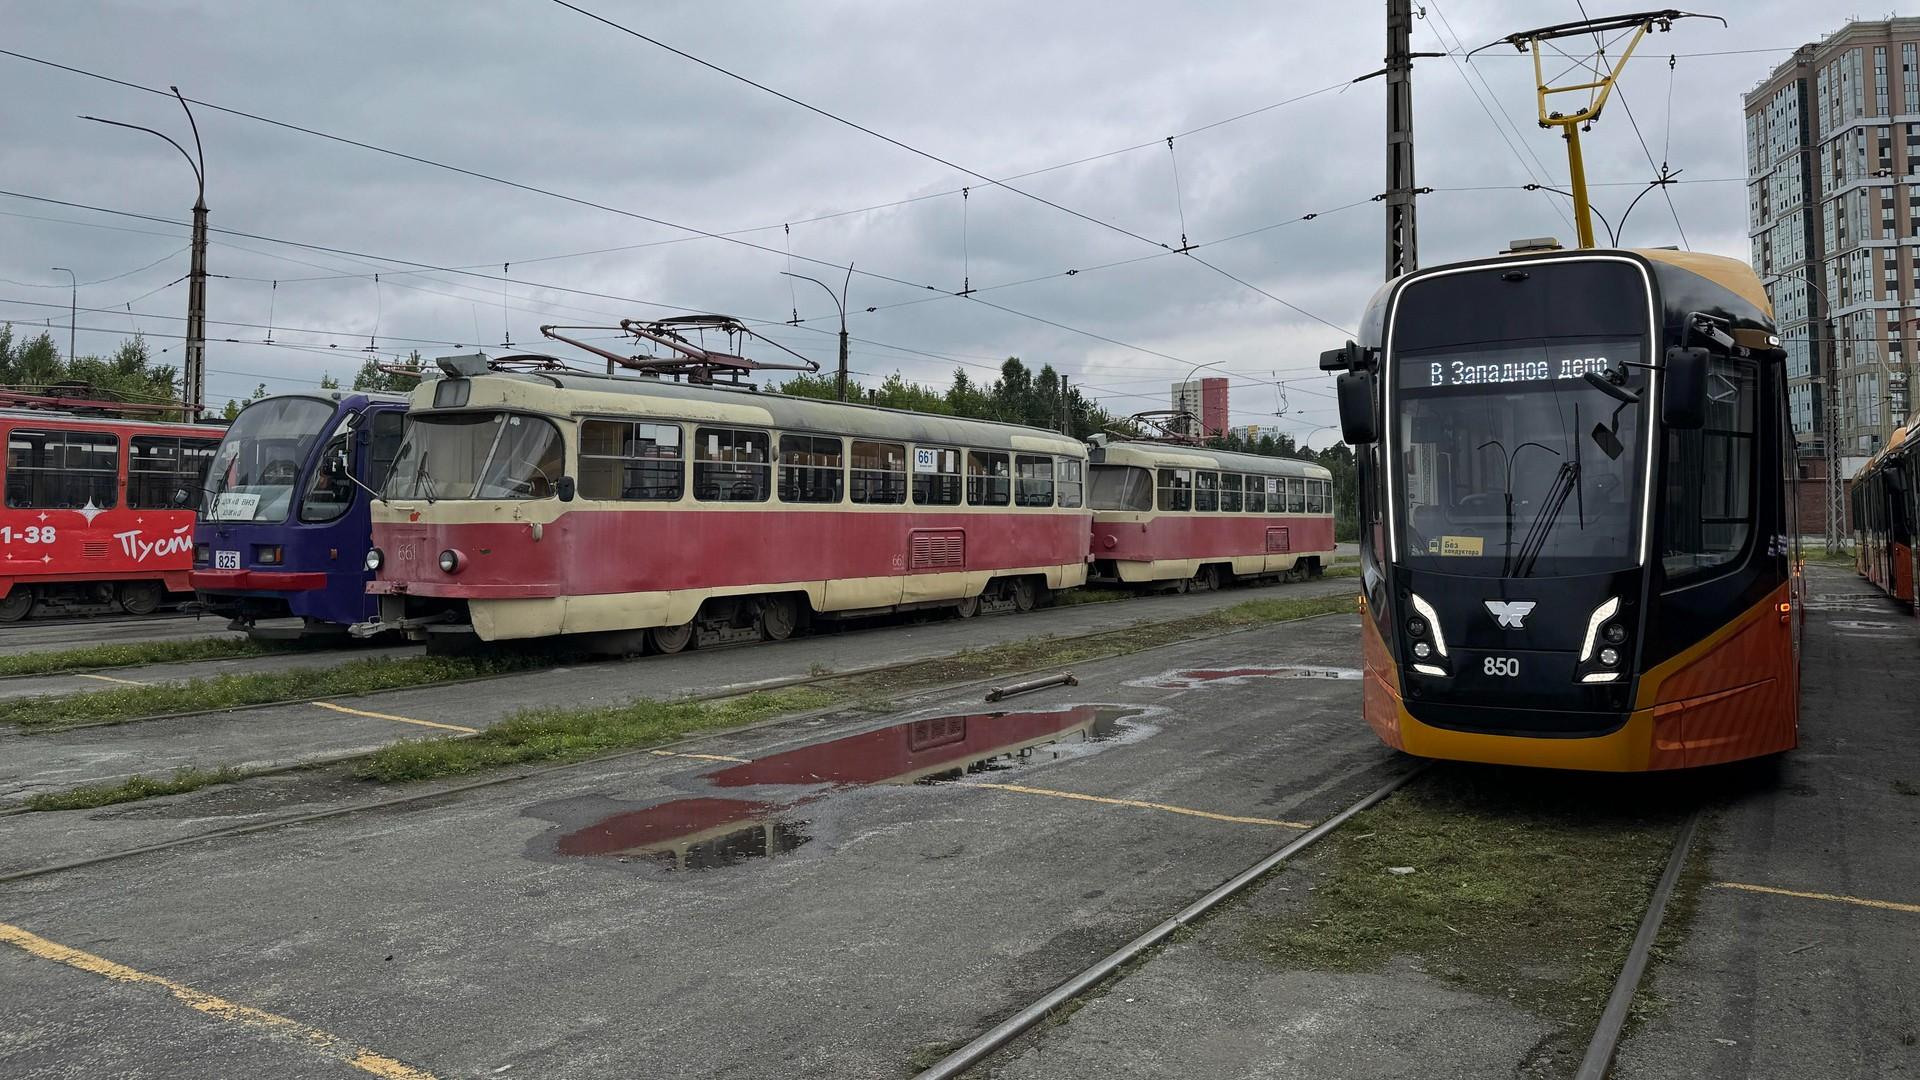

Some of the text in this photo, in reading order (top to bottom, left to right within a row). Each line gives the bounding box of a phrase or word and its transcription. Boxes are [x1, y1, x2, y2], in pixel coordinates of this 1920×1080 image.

[1431, 357, 1608, 386] В Западное депо
[918, 450, 933, 464] 661
[0, 526, 57, 544] 1-38
[399, 544, 416, 560] 661
[1444, 541, 1459, 549] Без
[218, 555, 236, 569] 825
[1483, 656, 1520, 677] 850
